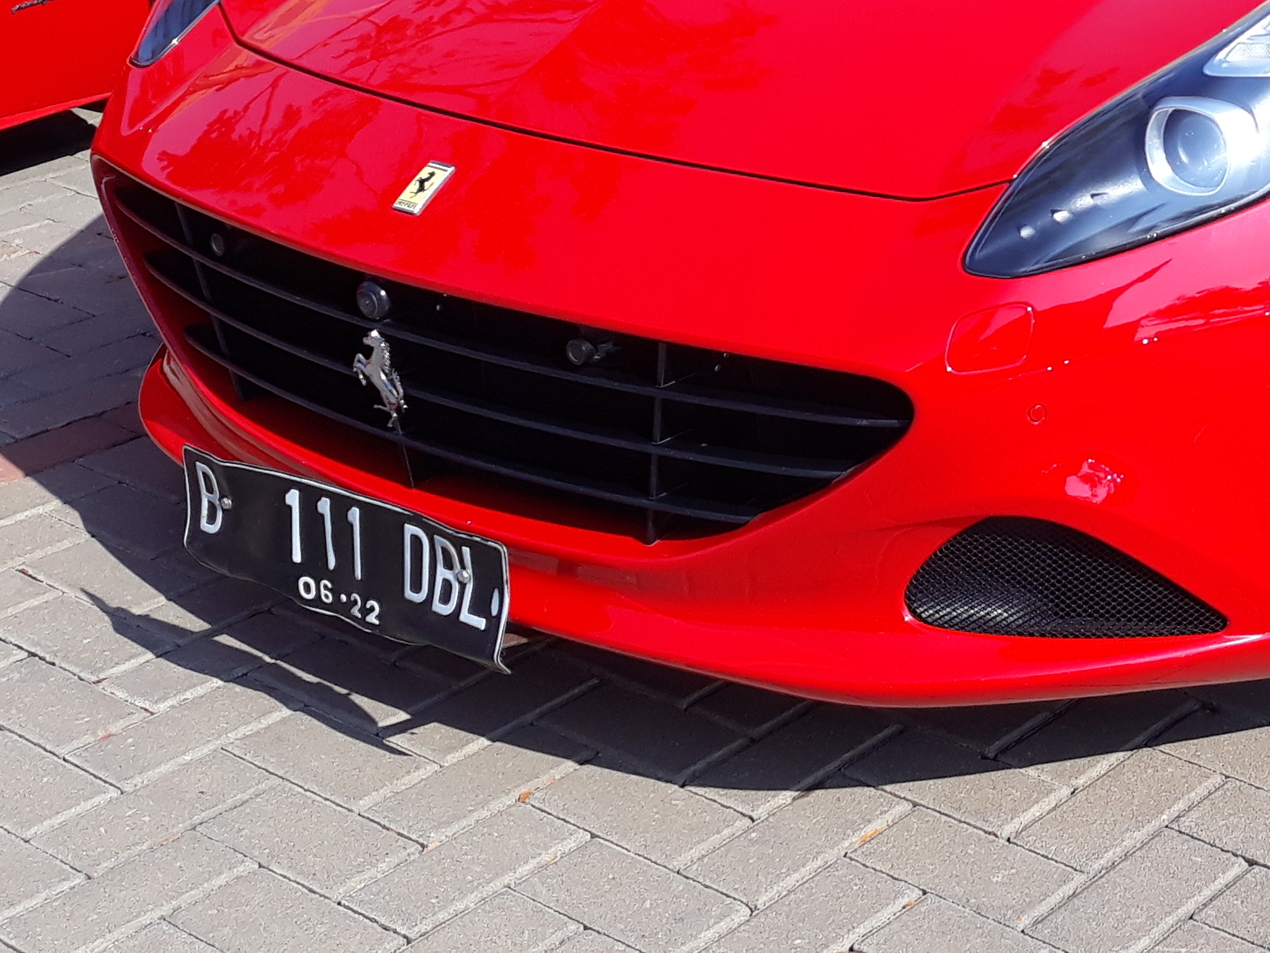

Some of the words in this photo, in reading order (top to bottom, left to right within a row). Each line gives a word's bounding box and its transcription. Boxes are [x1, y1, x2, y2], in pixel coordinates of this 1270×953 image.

[196, 461, 224, 535] B
[285, 489, 362, 581] 111
[404, 523, 487, 632] DBL
